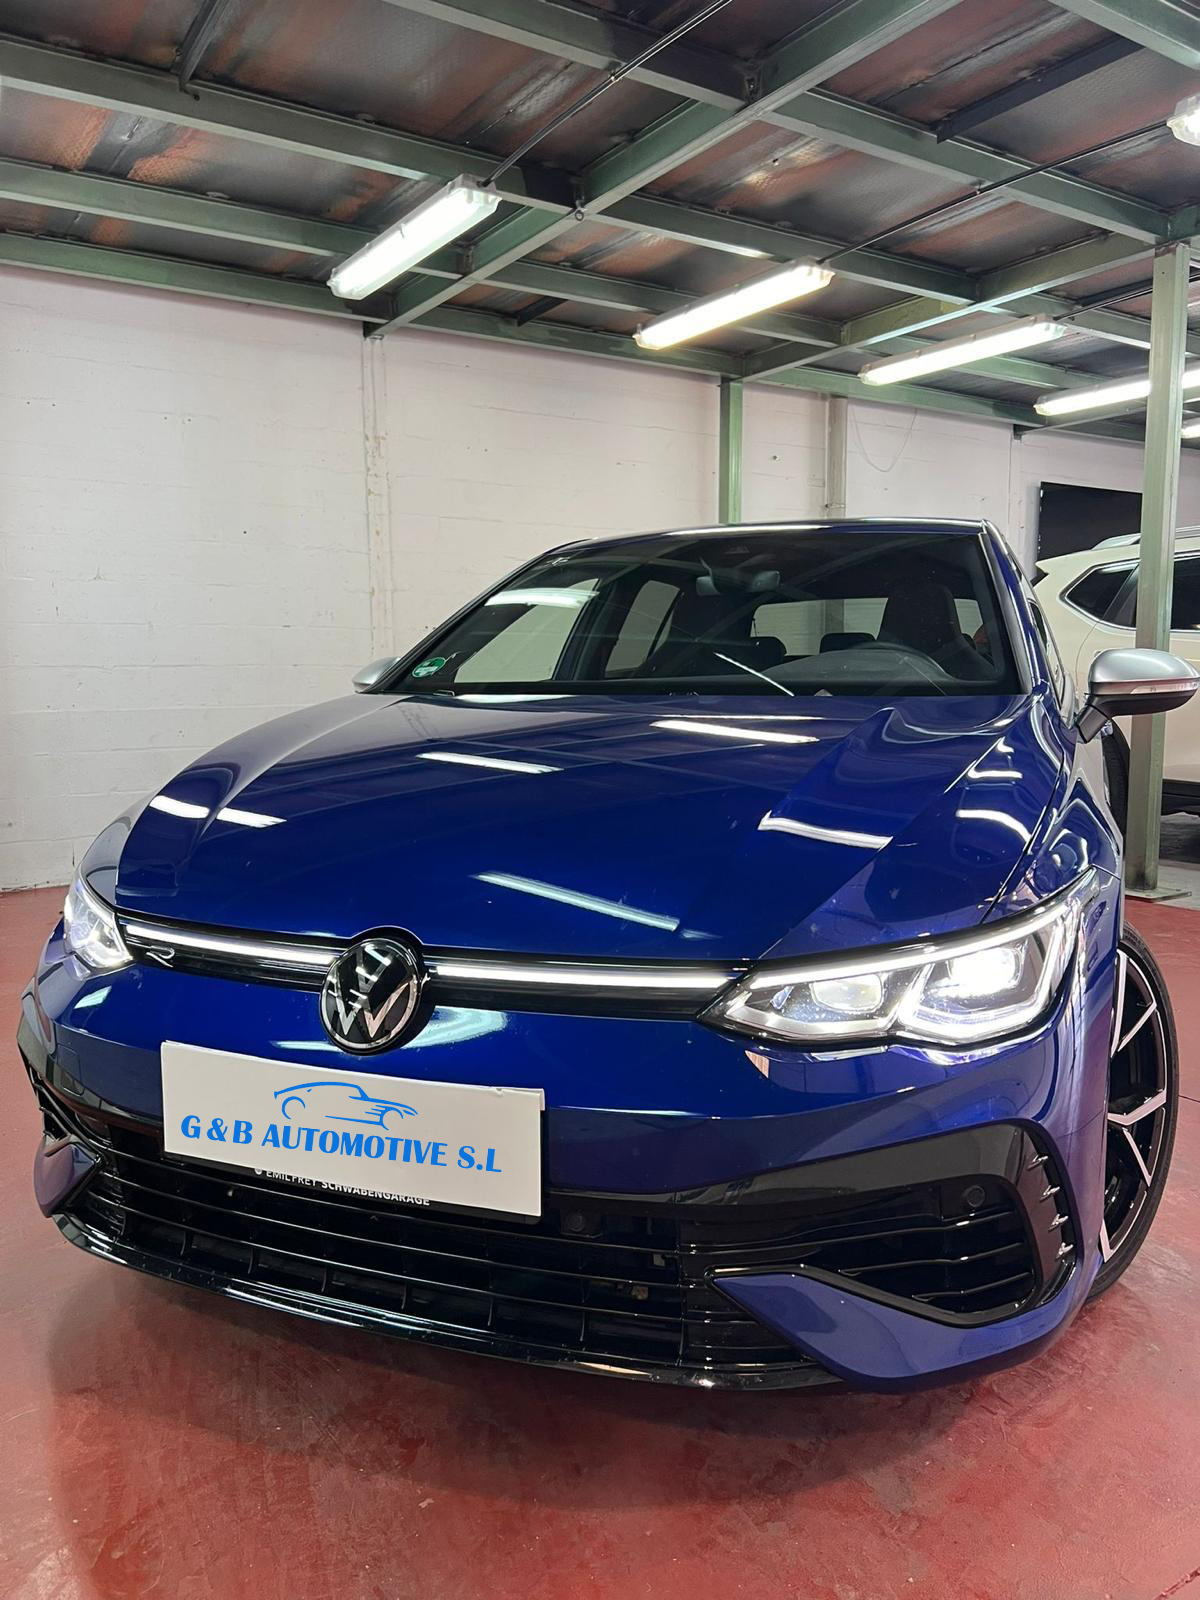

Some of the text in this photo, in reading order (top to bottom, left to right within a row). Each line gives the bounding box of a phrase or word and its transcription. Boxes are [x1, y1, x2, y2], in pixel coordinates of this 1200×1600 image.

[261, 1123, 448, 1167] AUTOMOTIVE
[457, 1145, 502, 1173] S.L
[321, 1181, 430, 1206] SCHWABENGARAGE
